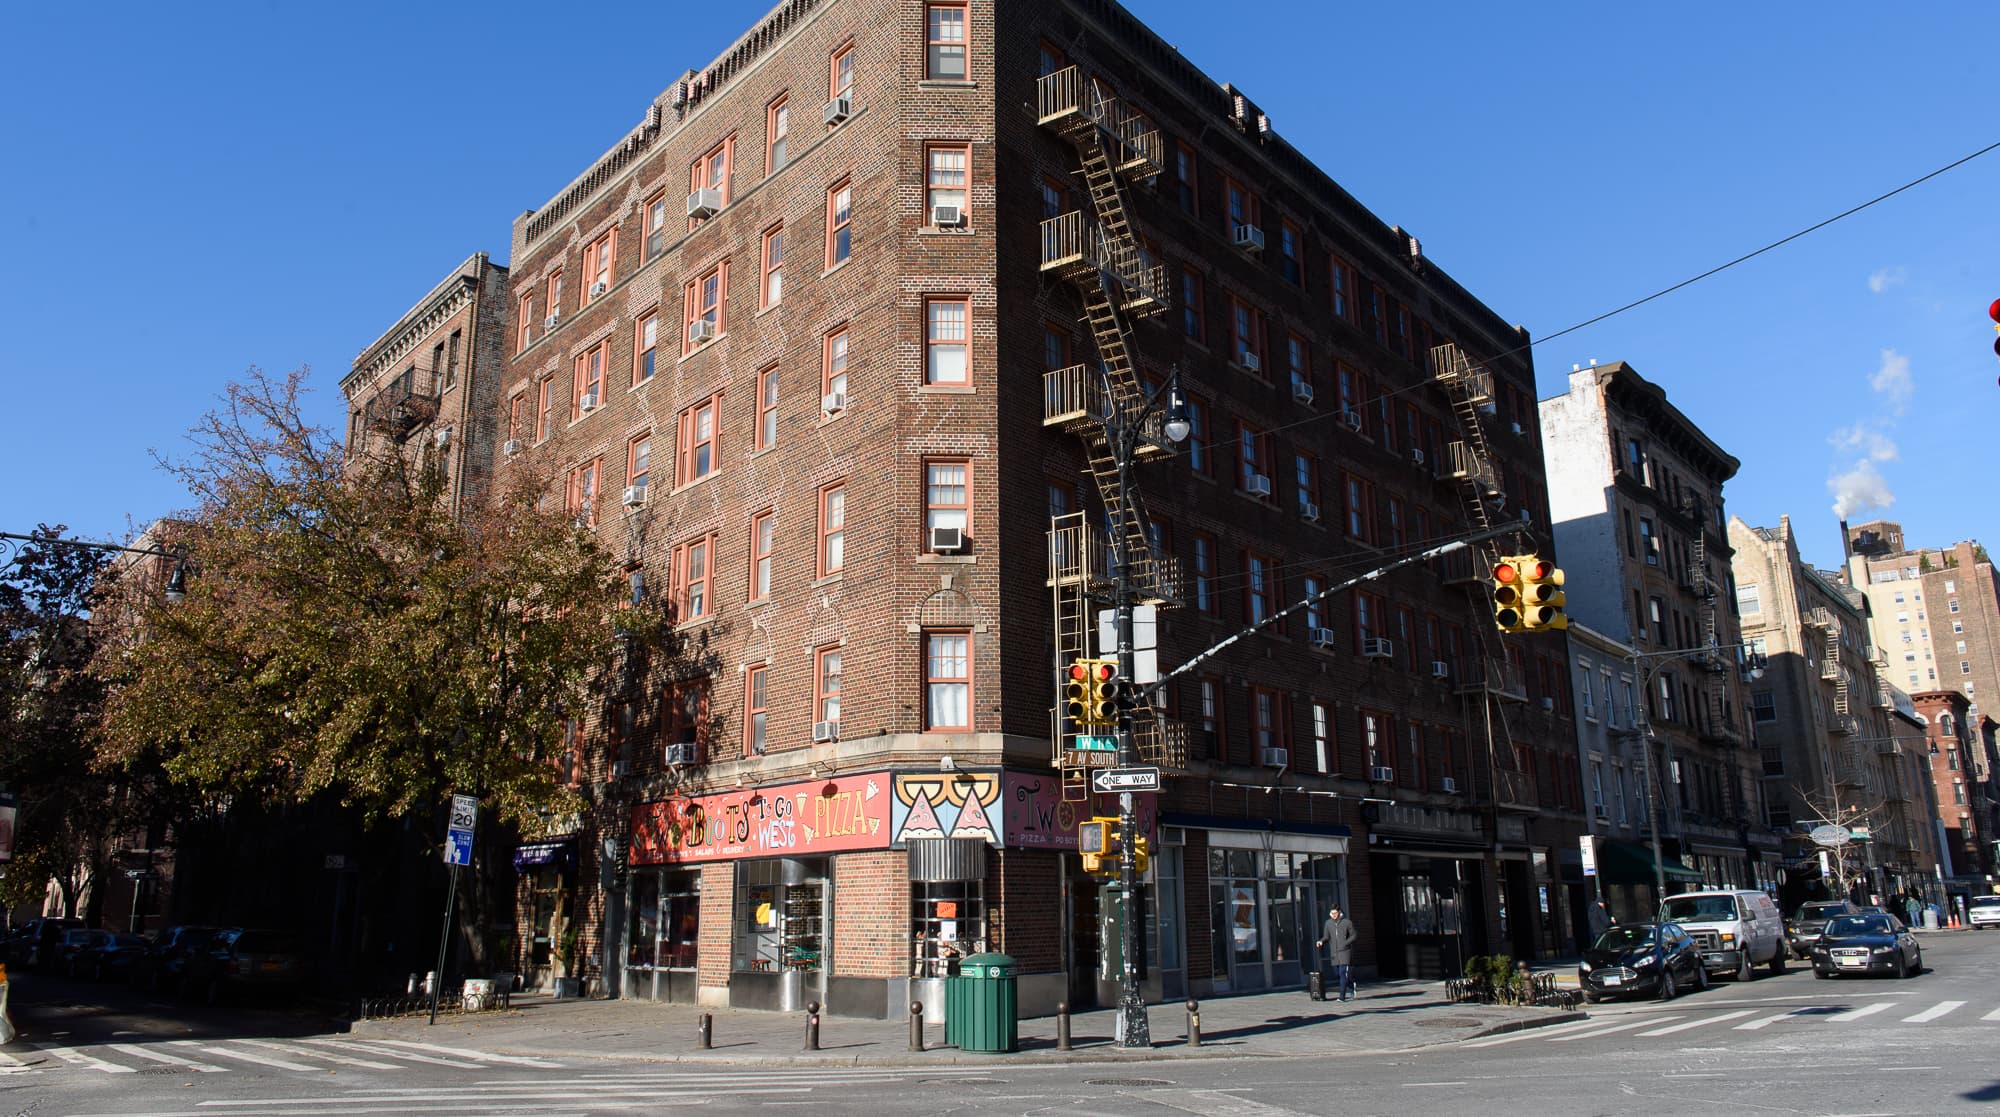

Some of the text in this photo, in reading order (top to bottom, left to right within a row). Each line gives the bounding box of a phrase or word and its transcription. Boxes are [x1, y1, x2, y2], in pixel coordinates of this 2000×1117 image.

[1082, 737, 1092, 750] W
[1068, 752, 1115, 765] 7 AV SOUTH
[1102, 775, 1153, 785] ONE WAY
[455, 798, 475, 807] SPEED
[1016, 780, 1076, 833] TWO
[455, 805, 474, 814] LIMIT
[814, 790, 867, 838] PIZZA
[454, 813, 473, 827] 20
[758, 816, 796, 851] WEST
[1020, 833, 1047, 843] PIZZA
